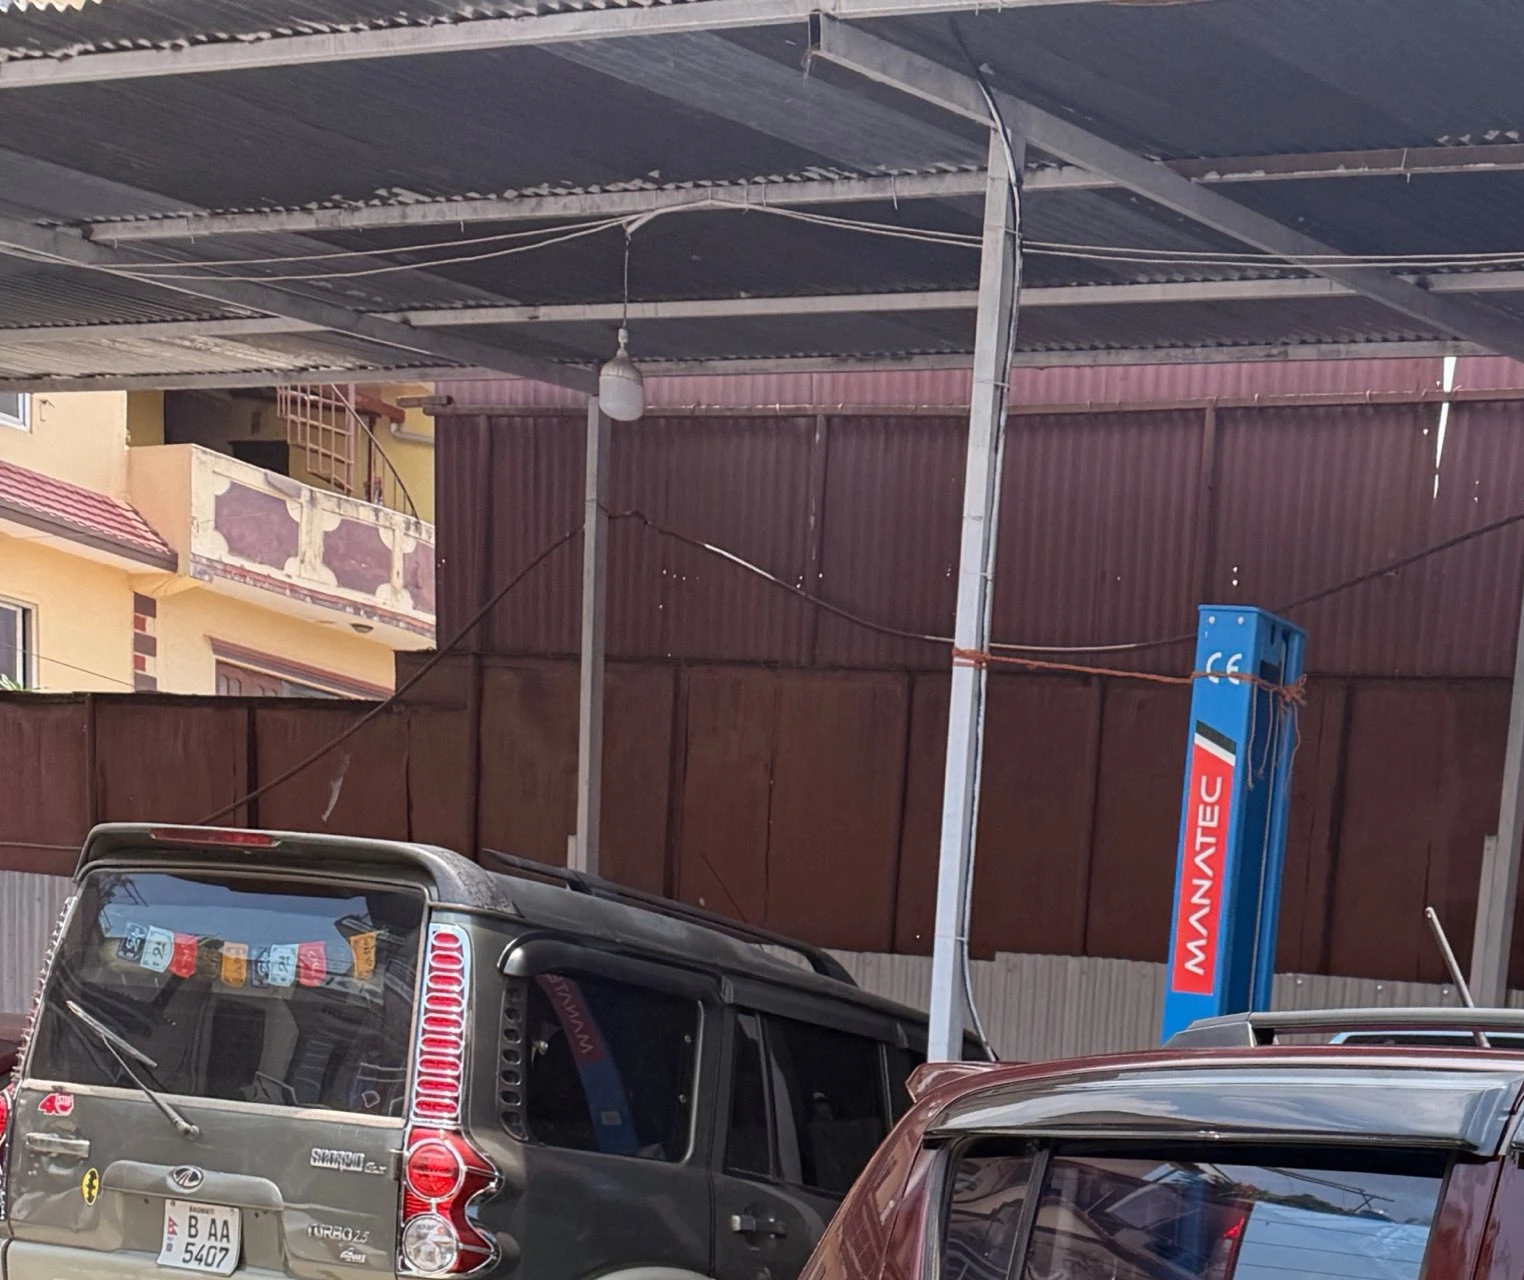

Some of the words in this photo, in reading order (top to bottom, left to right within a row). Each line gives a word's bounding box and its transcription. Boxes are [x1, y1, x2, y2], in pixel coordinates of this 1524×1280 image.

[1206, 651, 1243, 685] CE
[1184, 775, 1223, 976] MANATEC
[188, 1214, 199, 1239] B
[207, 1217, 231, 1243] AA
[308, 1223, 353, 1241] TURBO
[182, 1241, 230, 1269] 5407
